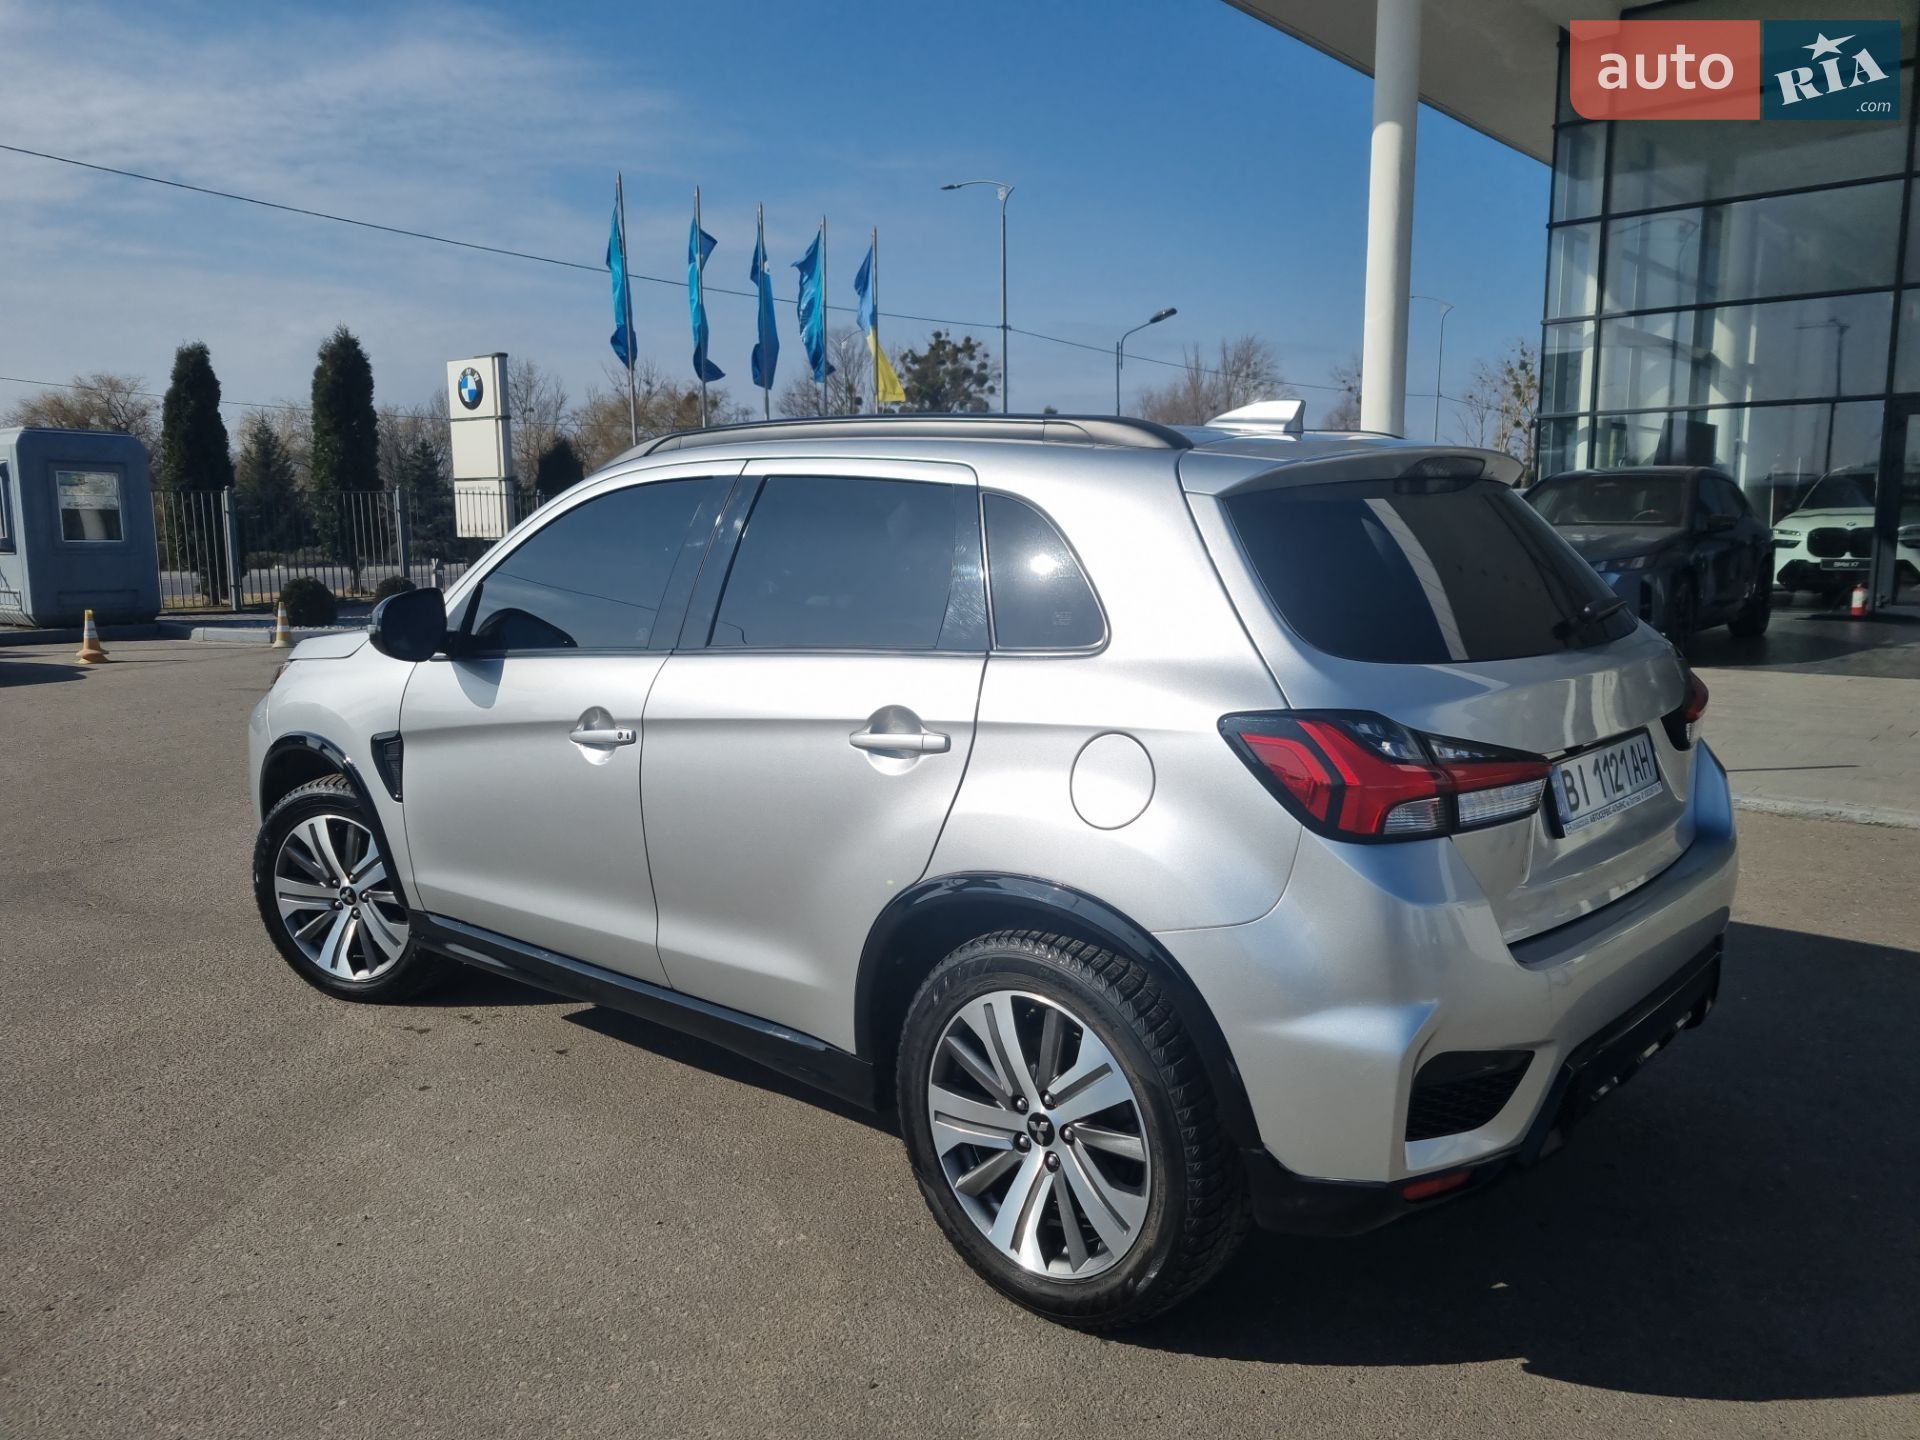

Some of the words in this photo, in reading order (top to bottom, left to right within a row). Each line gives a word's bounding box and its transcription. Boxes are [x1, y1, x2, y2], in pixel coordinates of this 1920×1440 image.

[1561, 764, 1591, 813] BI
[1593, 748, 1634, 799] 1121
[1630, 740, 1653, 784] AH
